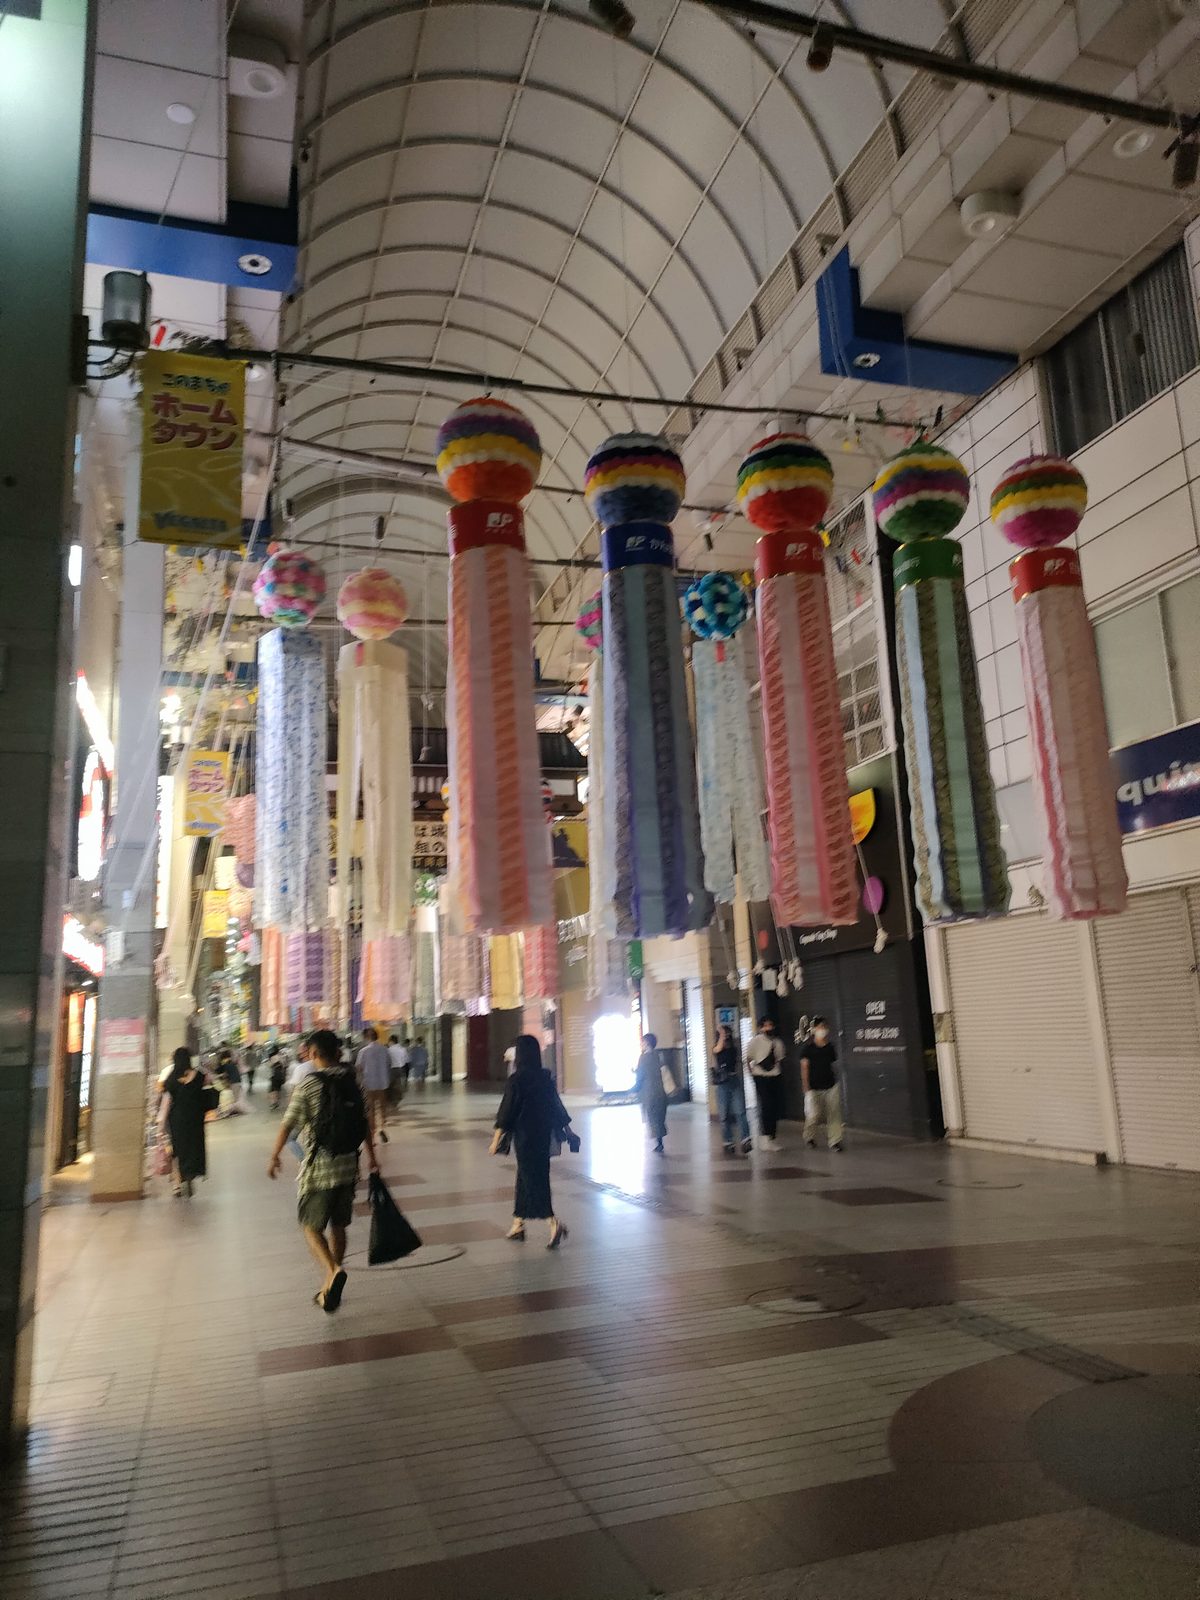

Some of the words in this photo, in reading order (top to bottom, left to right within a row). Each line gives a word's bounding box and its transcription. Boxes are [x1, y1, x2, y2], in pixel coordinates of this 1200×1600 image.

[152, 393, 237, 425] ホーム
[151, 419, 237, 451] タウン
[865, 1000, 886, 1015] OPEN
